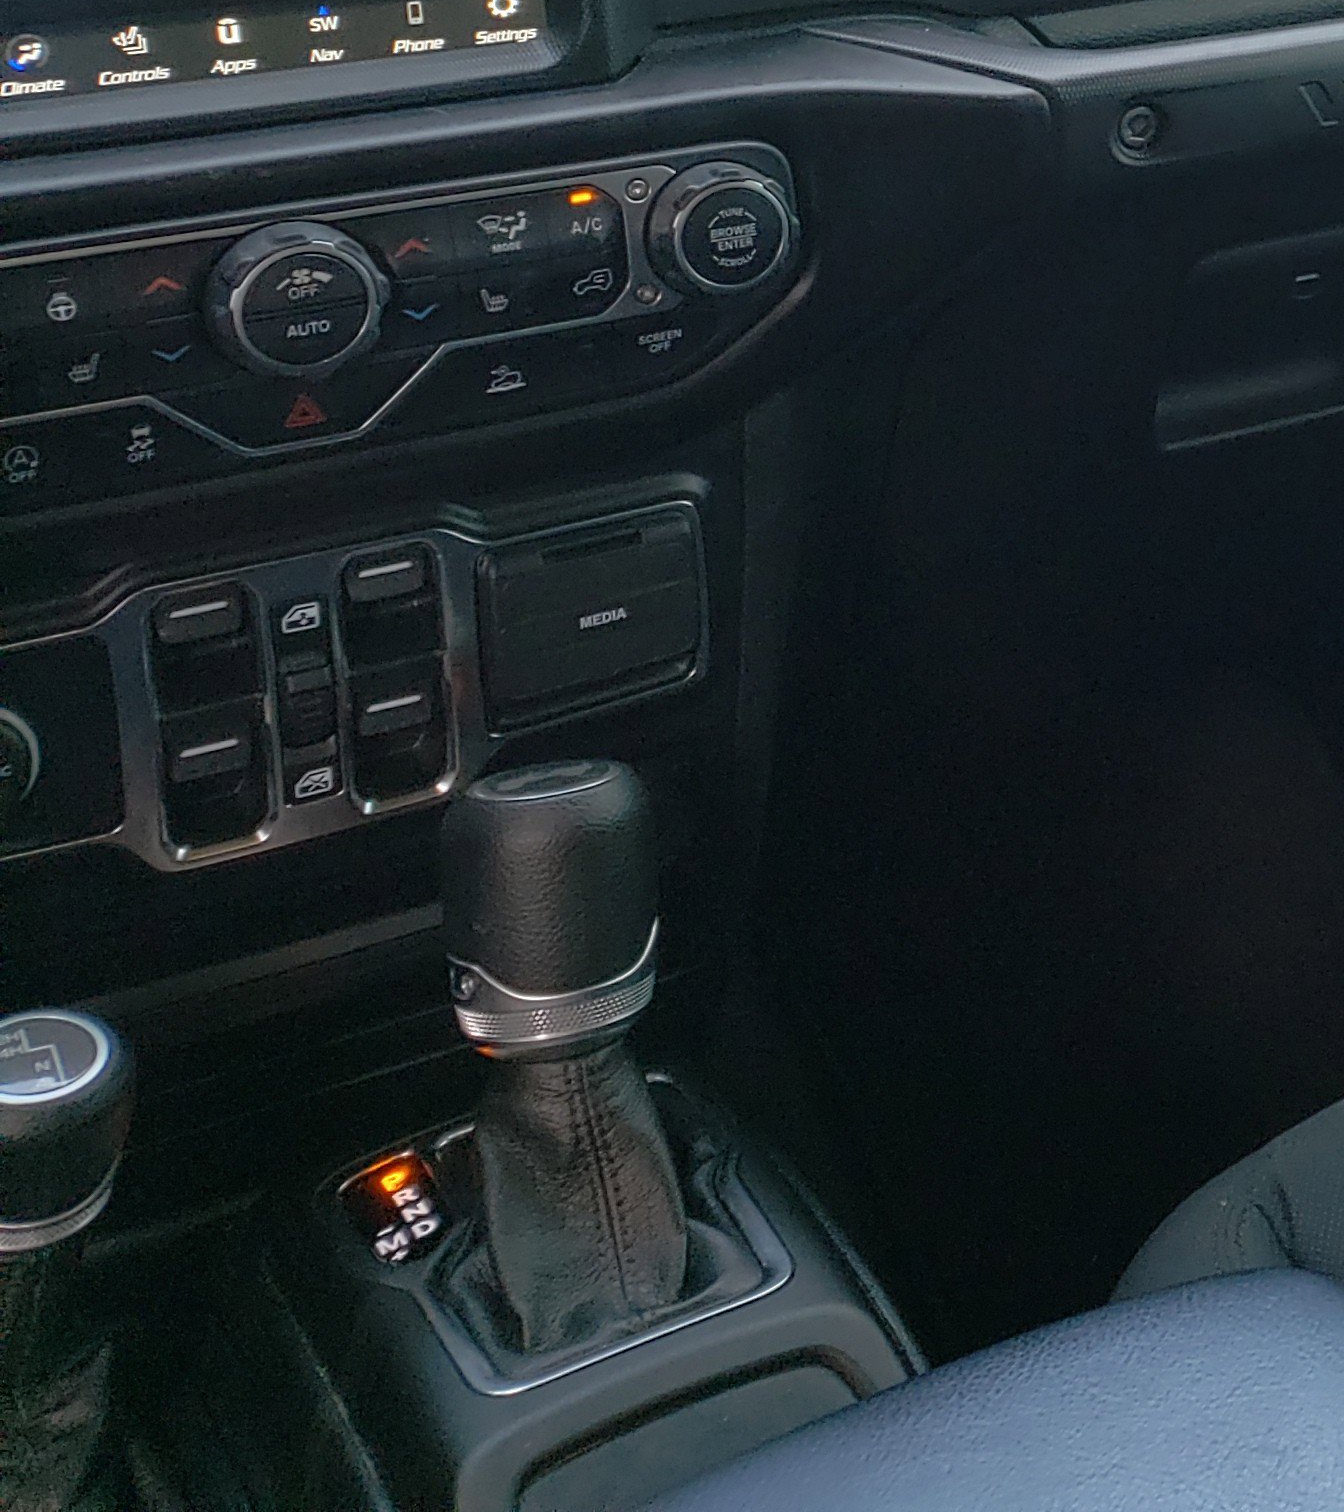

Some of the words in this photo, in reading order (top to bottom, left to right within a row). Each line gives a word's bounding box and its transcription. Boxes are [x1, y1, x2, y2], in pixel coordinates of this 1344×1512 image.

[309, 16, 339, 32] SW
[393, 37, 445, 54] Phone
[474, 28, 539, 46] Settings
[310, 48, 344, 63] Nav
[211, 57, 257, 76] Apps
[98, 66, 171, 86] Controls
[0, 79, 67, 97] Climate
[718, 207, 744, 219] TUNE
[570, 217, 603, 236] A/C
[711, 222, 757, 240] BROWSE
[718, 236, 754, 252] ENTER
[287, 283, 321, 301] OFF
[286, 320, 331, 339] AUTO
[638, 328, 682, 346] SCREEN
[649, 340, 672, 354] OFF
[127, 448, 156, 464] OFF
[579, 607, 628, 630] MEDIA
[391, 1186, 420, 1207] R
[401, 1199, 431, 1224] N
[410, 1219, 440, 1240] D
[375, 1231, 409, 1257] M
